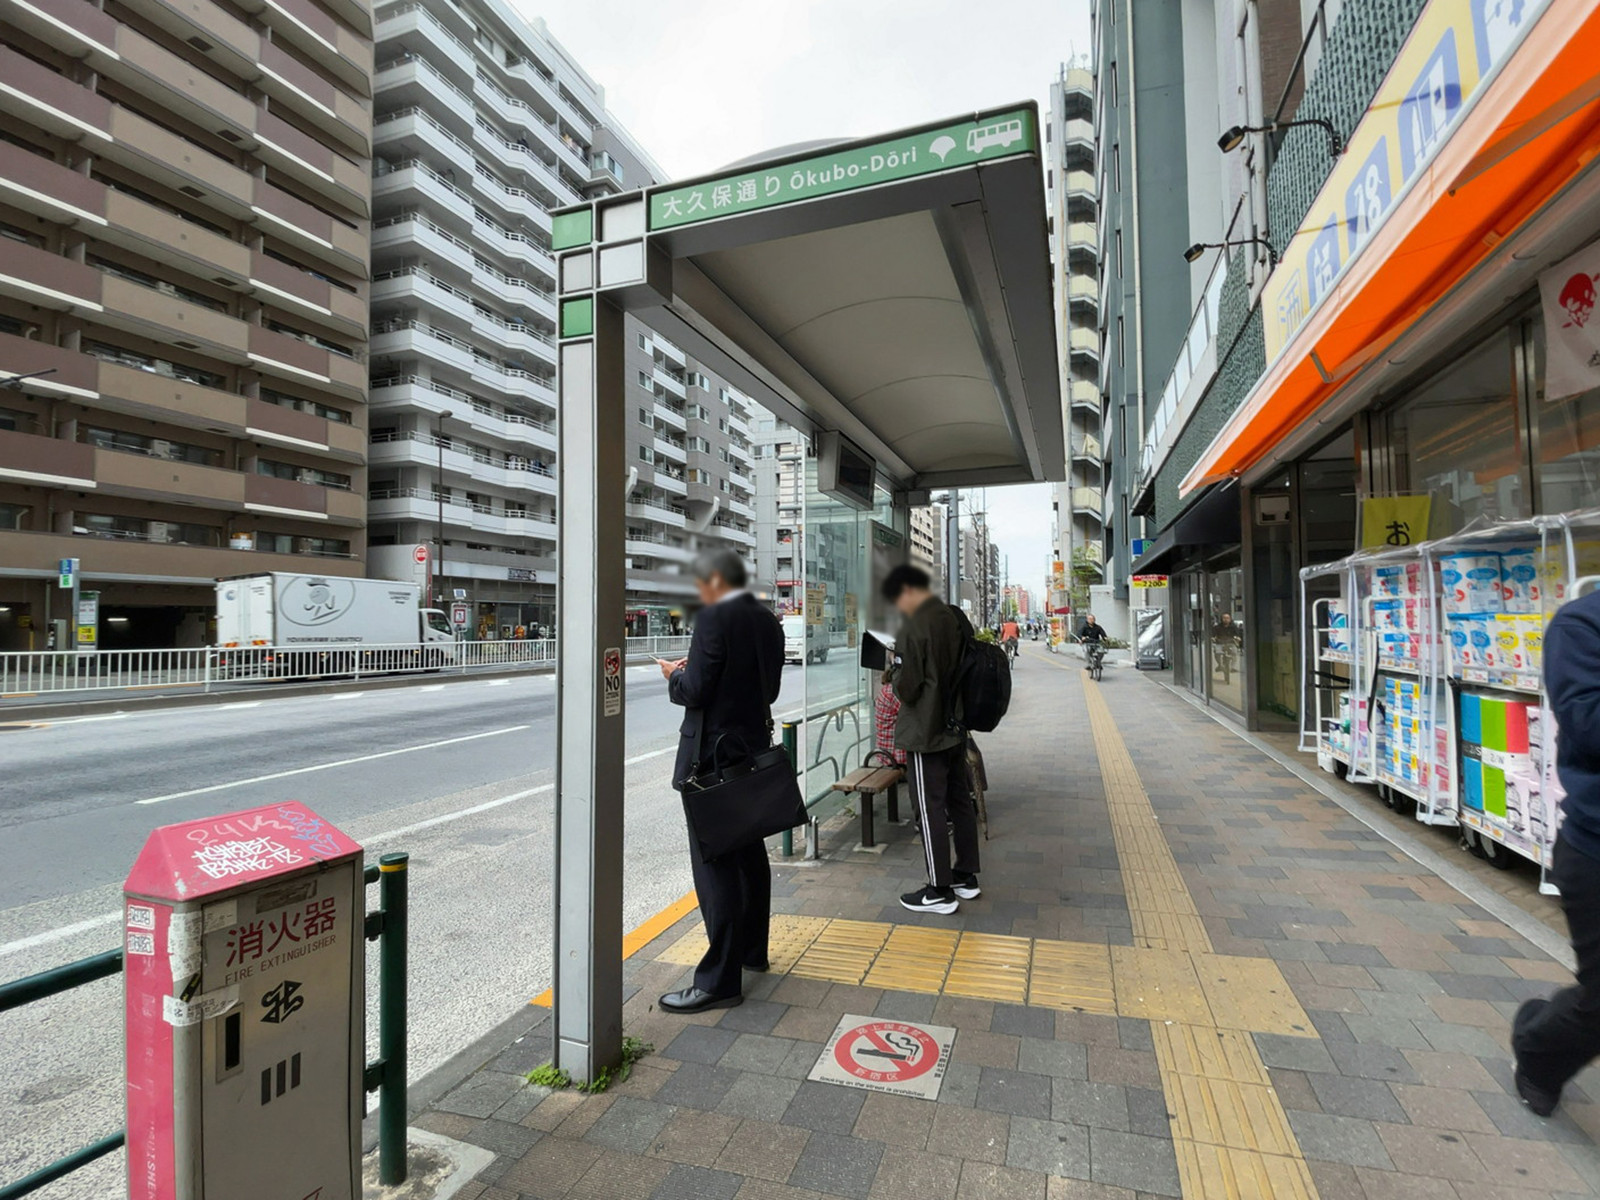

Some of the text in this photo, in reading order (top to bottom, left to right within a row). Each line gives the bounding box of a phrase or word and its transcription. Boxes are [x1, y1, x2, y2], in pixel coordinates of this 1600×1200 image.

[662, 146, 917, 219] 大久保通り Ōkubo-Dōri
[1386, 520, 1410, 546] お
[605, 675, 620, 693] NO
[225, 897, 337, 968] 消火器
[225, 934, 337, 985] FIRE EXTINGUISHER
